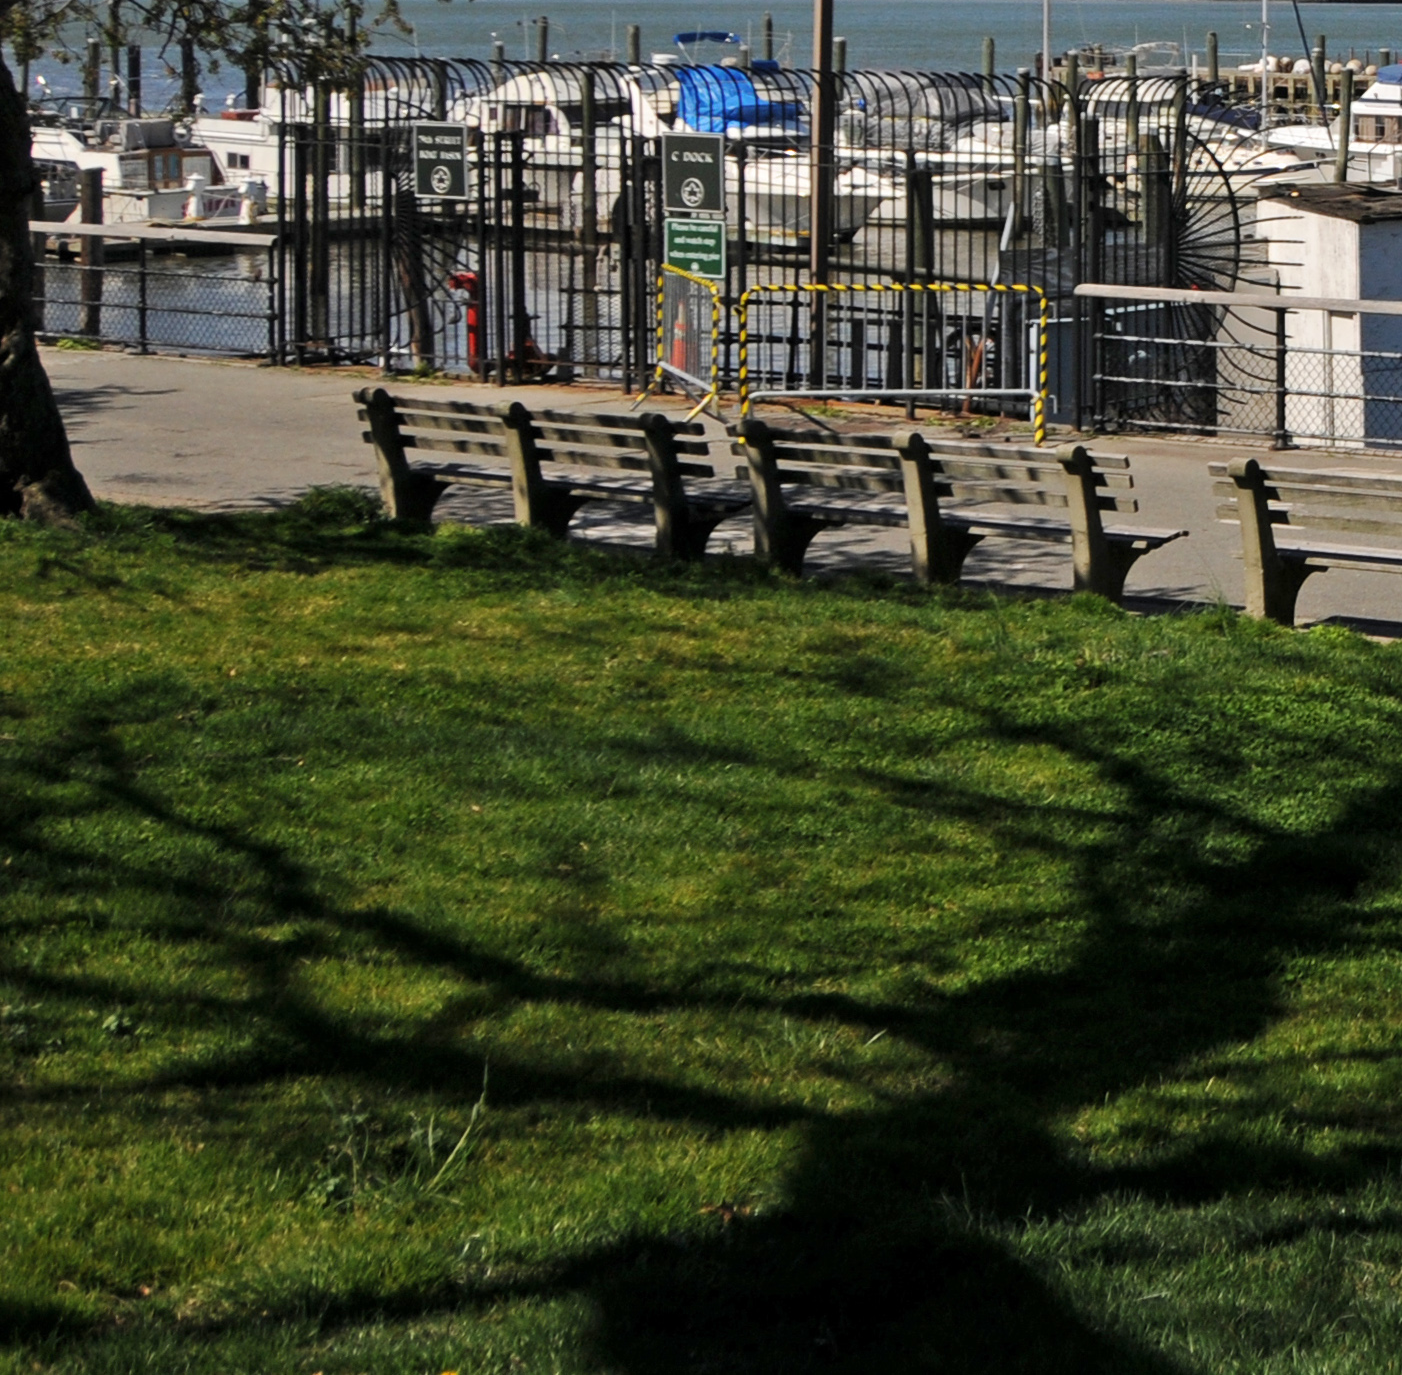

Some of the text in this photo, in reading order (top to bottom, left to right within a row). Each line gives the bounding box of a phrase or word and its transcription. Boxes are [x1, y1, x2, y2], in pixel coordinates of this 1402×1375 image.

[434, 135, 461, 145] STREET
[671, 151, 714, 163] C DOCK
